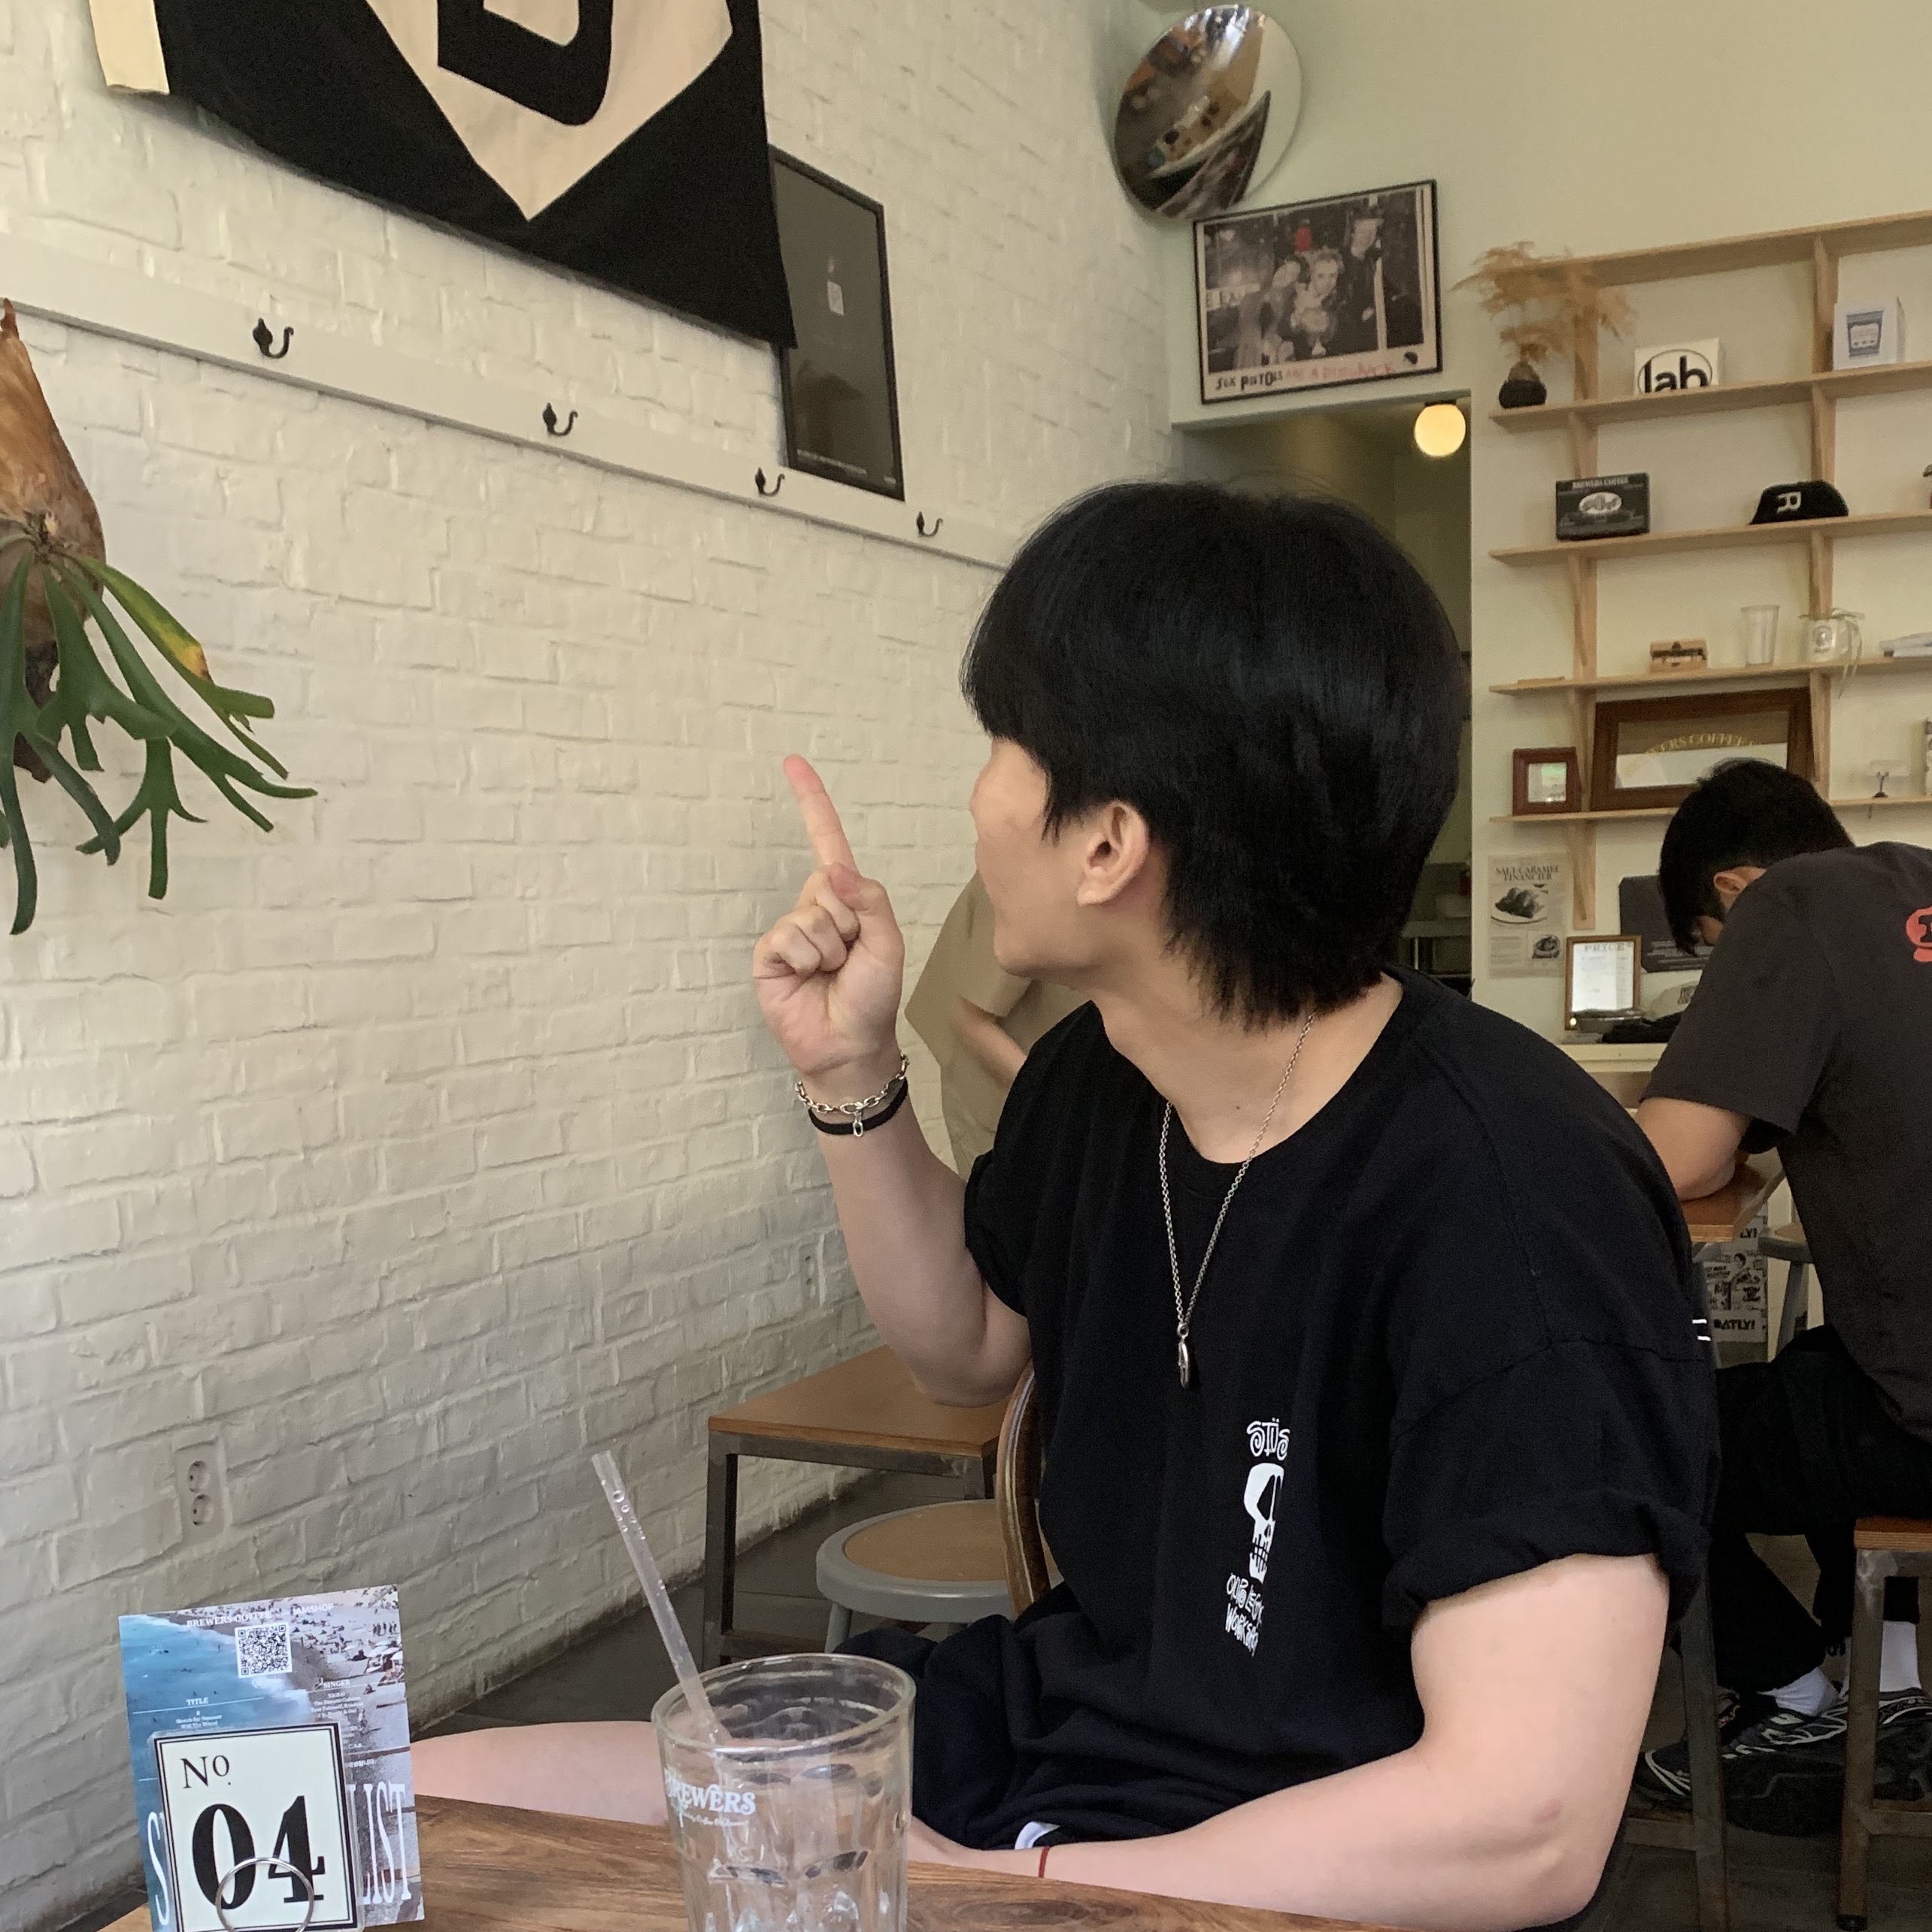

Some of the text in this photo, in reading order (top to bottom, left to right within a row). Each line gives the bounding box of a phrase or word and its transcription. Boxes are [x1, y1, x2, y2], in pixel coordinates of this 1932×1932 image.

[187, 1616, 232, 1628] BREWERS
[323, 1679, 350, 1688] SINGER
[185, 1697, 209, 1706] TITLE
[192, 1795, 326, 1910] 04
